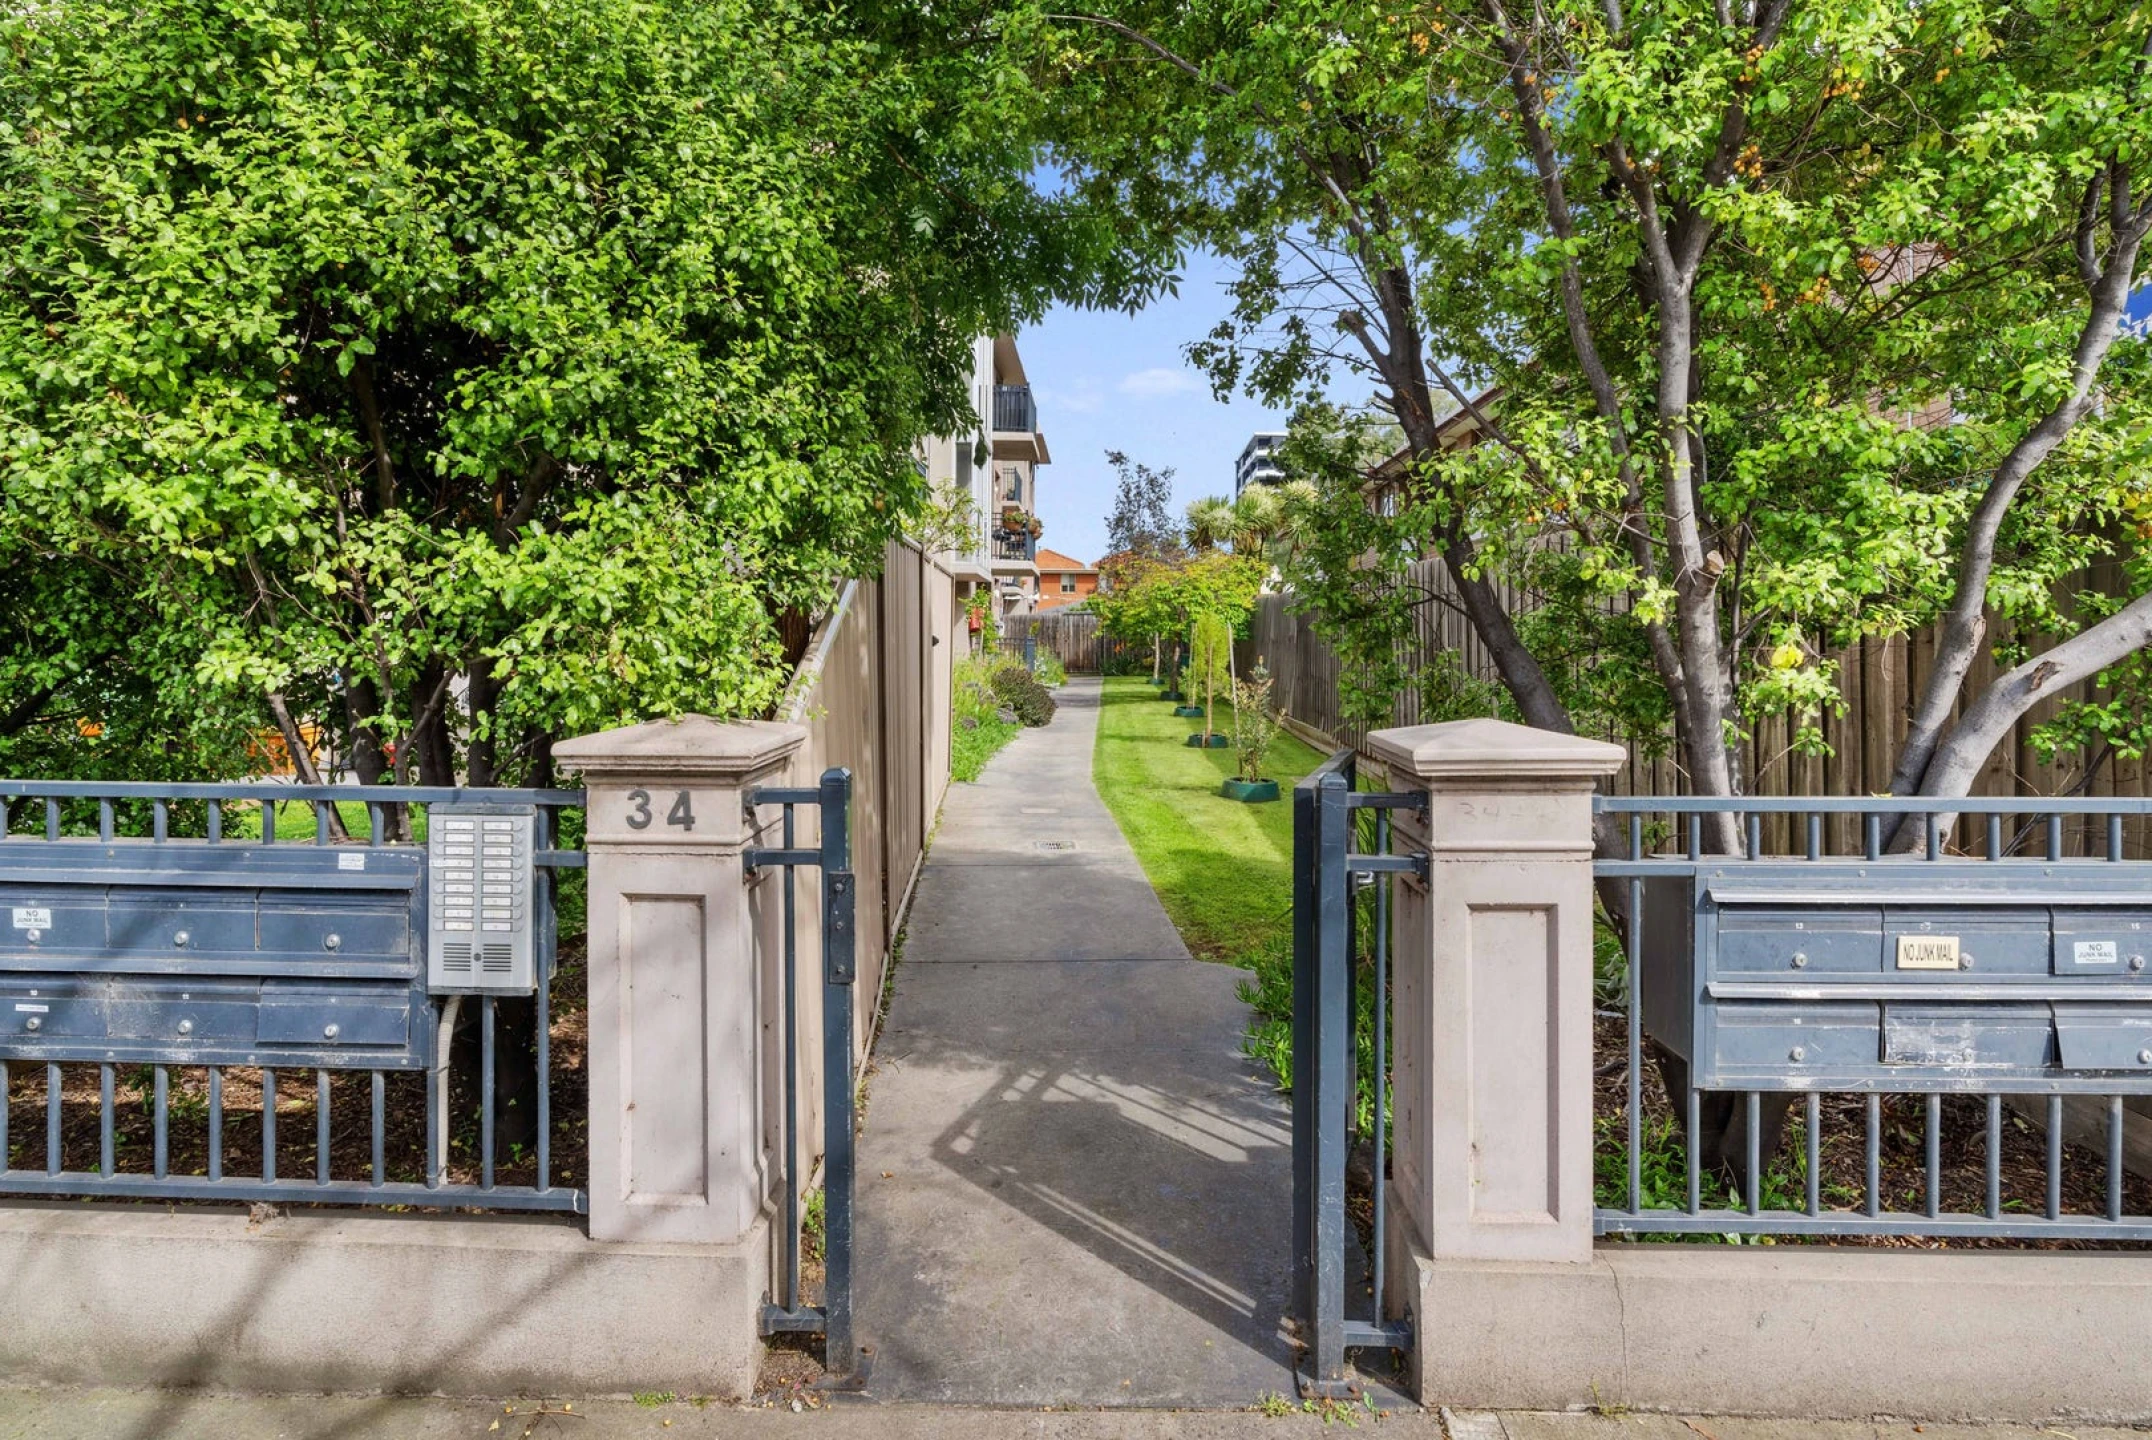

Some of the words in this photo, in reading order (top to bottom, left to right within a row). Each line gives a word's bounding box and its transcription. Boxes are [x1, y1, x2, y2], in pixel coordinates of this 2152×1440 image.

[626, 789, 696, 831] 34
[26, 909, 39, 918] NO
[1904, 943, 1914, 961] NO
[1916, 943, 1935, 961] JUNK
[1936, 943, 1954, 961] MAIL
[2088, 943, 2103, 951] NO
